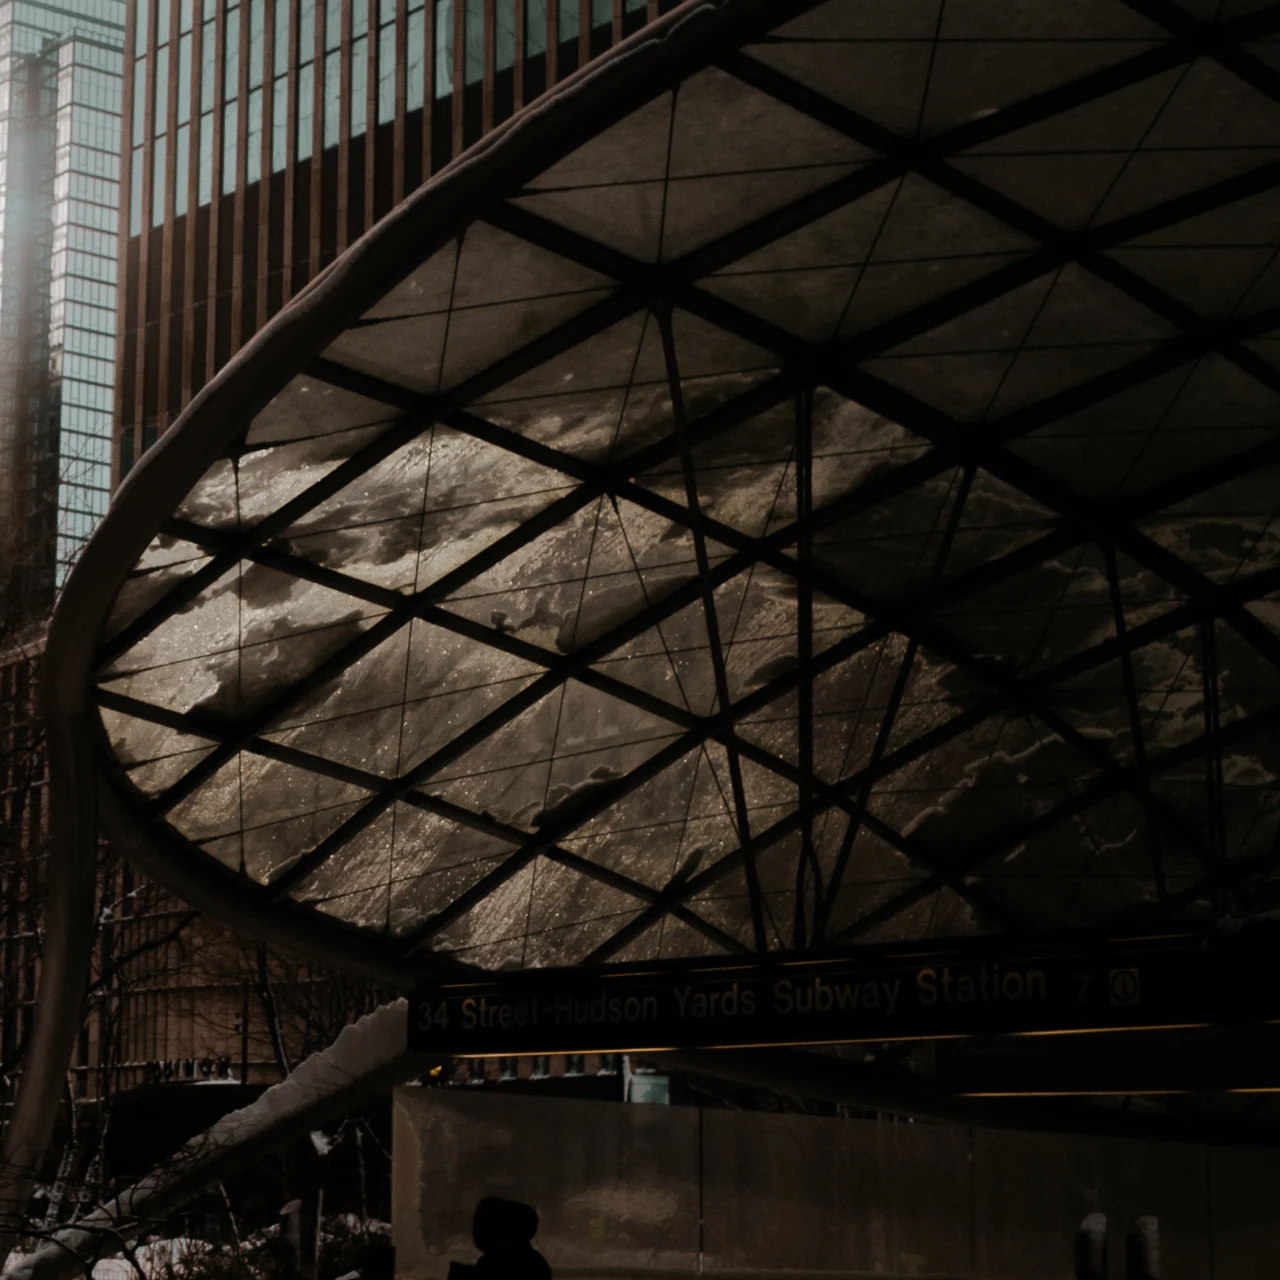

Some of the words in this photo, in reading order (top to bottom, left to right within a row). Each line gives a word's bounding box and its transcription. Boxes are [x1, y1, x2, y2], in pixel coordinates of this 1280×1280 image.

[419, 1001, 450, 1032] 34
[461, 989, 658, 1031] Street-Hudson
[673, 981, 756, 1020] Yards
[773, 976, 900, 1017] Subway
[915, 963, 1047, 1006] Station
[1073, 972, 1093, 1005] 7
